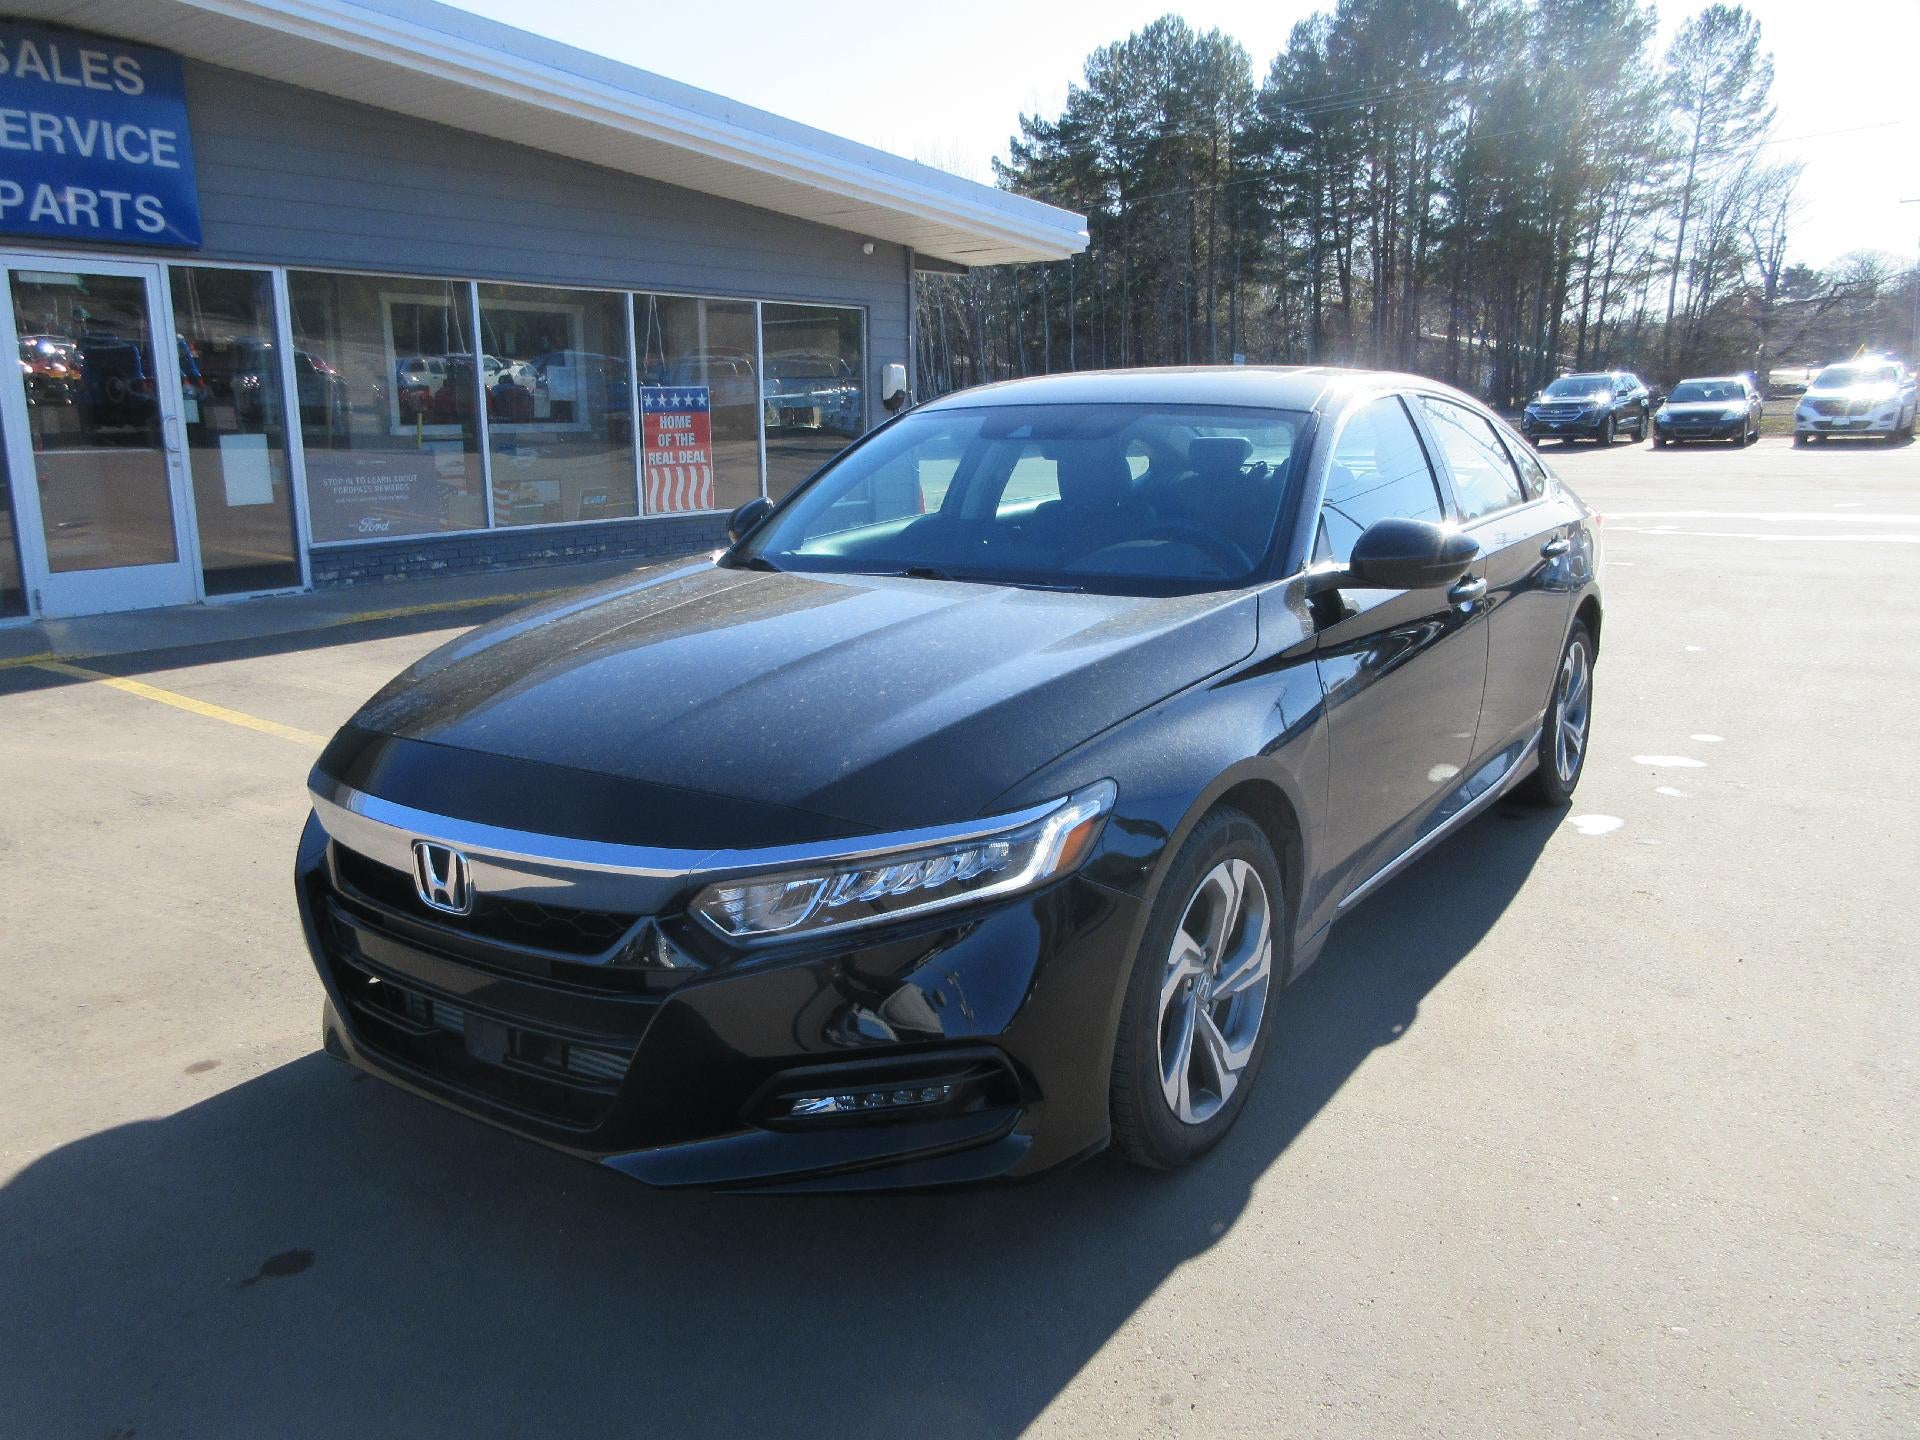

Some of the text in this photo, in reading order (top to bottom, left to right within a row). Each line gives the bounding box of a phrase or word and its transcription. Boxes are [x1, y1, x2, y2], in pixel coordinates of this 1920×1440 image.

[0, 108, 181, 169] ERVICE
[0, 180, 166, 233] PARTS
[660, 415, 692, 429] HOME
[657, 432, 695, 447] OF THE
[648, 450, 707, 465] REAL DEAL
[322, 478, 343, 487] STOP
[356, 476, 366, 485] TO
[367, 475, 391, 484] LEARN
[358, 517, 390, 532] Ford
